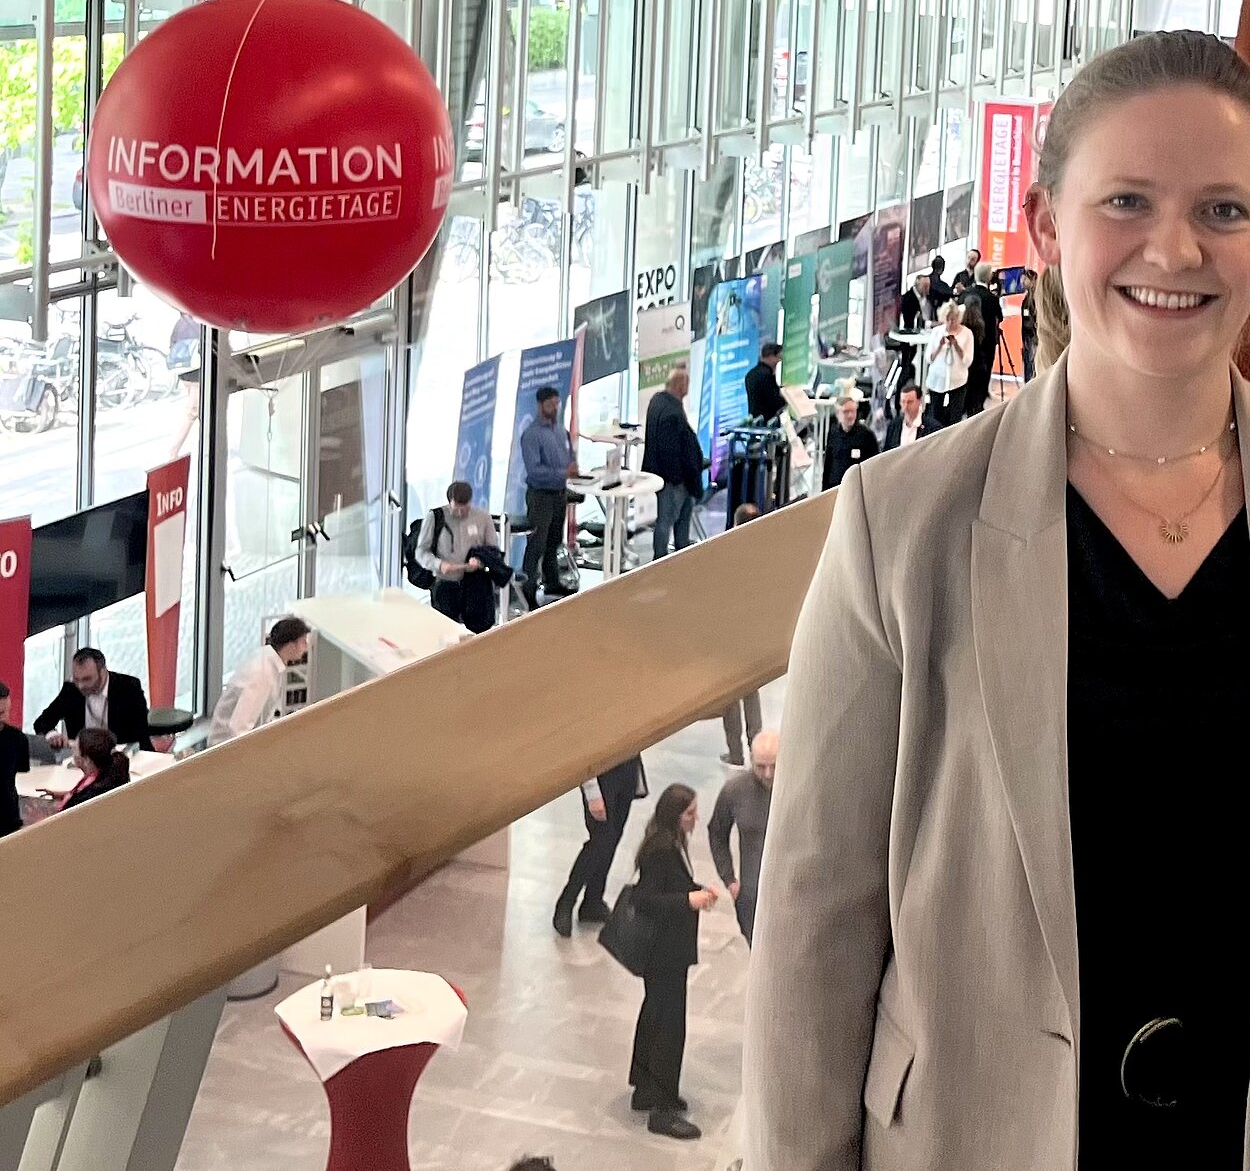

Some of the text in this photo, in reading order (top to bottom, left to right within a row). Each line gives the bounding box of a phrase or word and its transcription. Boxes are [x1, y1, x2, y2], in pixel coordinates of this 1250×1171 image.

[108, 136, 402, 185] INFORMATION
[115, 185, 394, 222] Berliner ENERGIETAGE
[637, 264, 676, 300] EXPO
[156, 486, 183, 517] INFO
